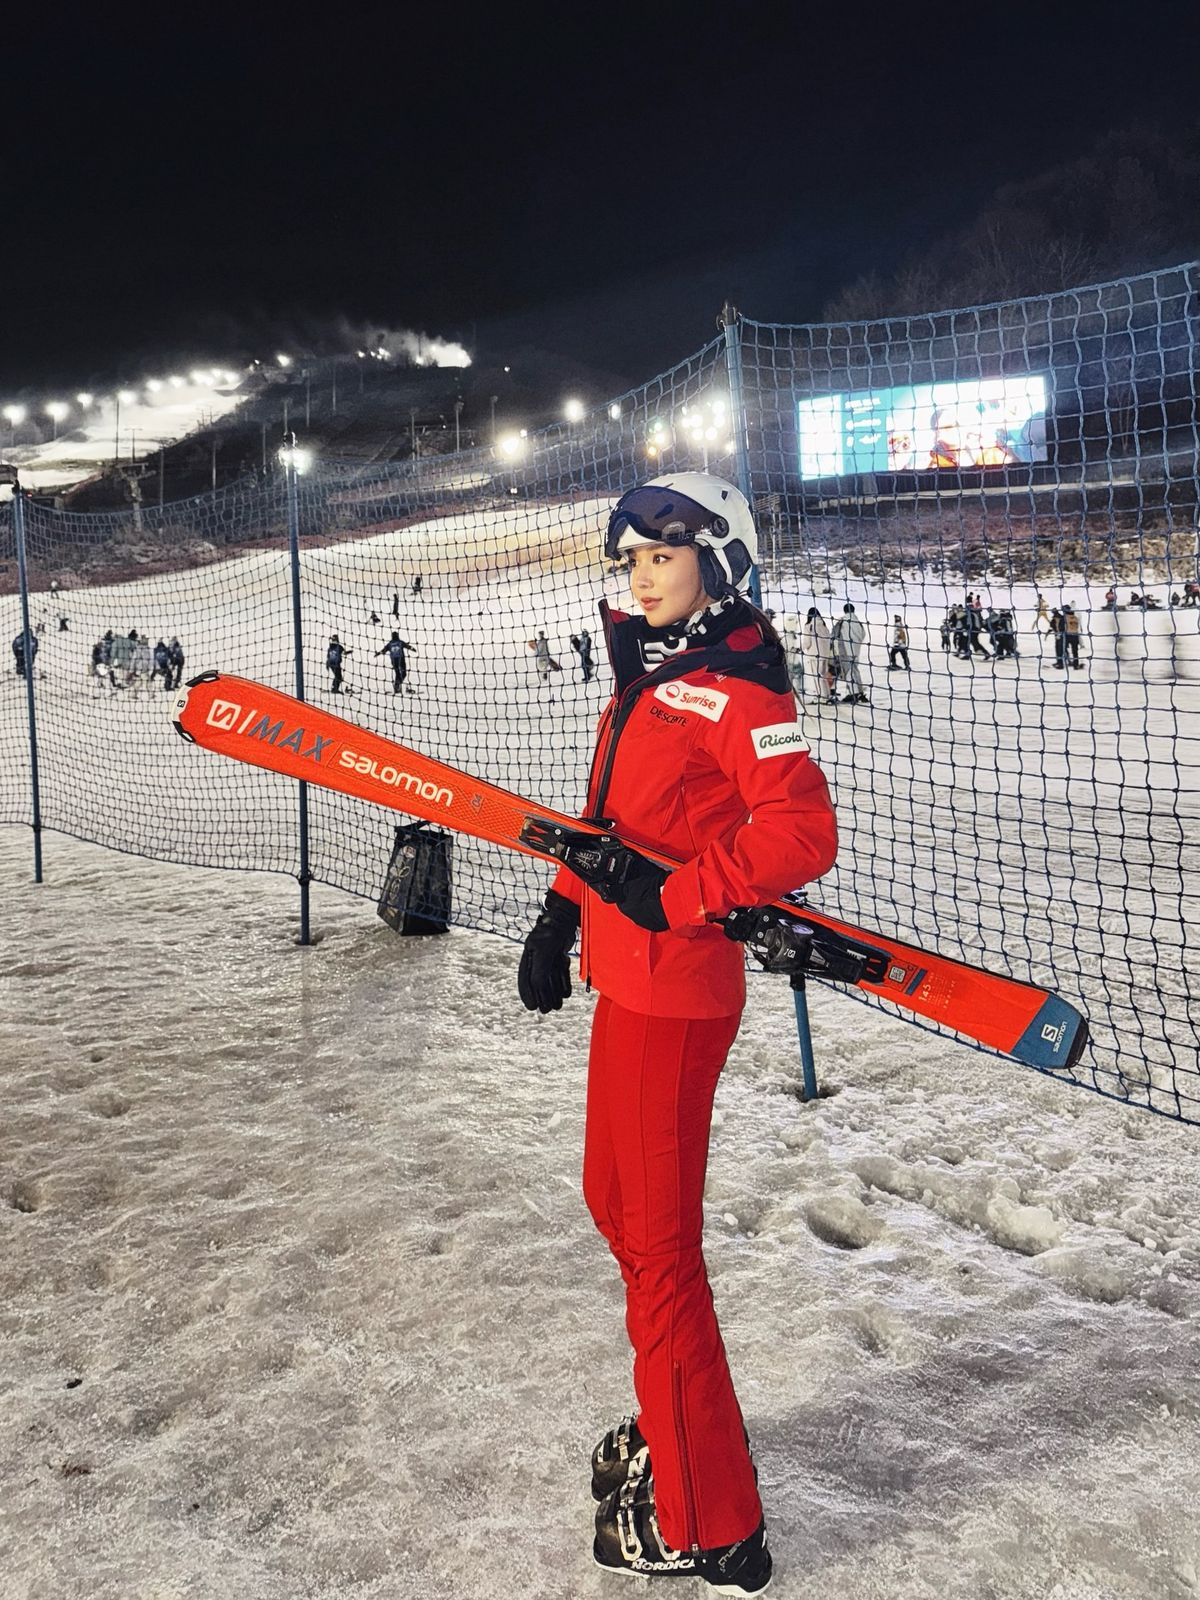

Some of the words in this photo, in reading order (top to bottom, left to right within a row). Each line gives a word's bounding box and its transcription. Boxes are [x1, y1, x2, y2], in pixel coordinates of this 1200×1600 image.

[680, 692, 717, 711] Sunrise
[759, 731, 803, 749] Ricola
[631, 1558, 695, 1570] NORDICA
